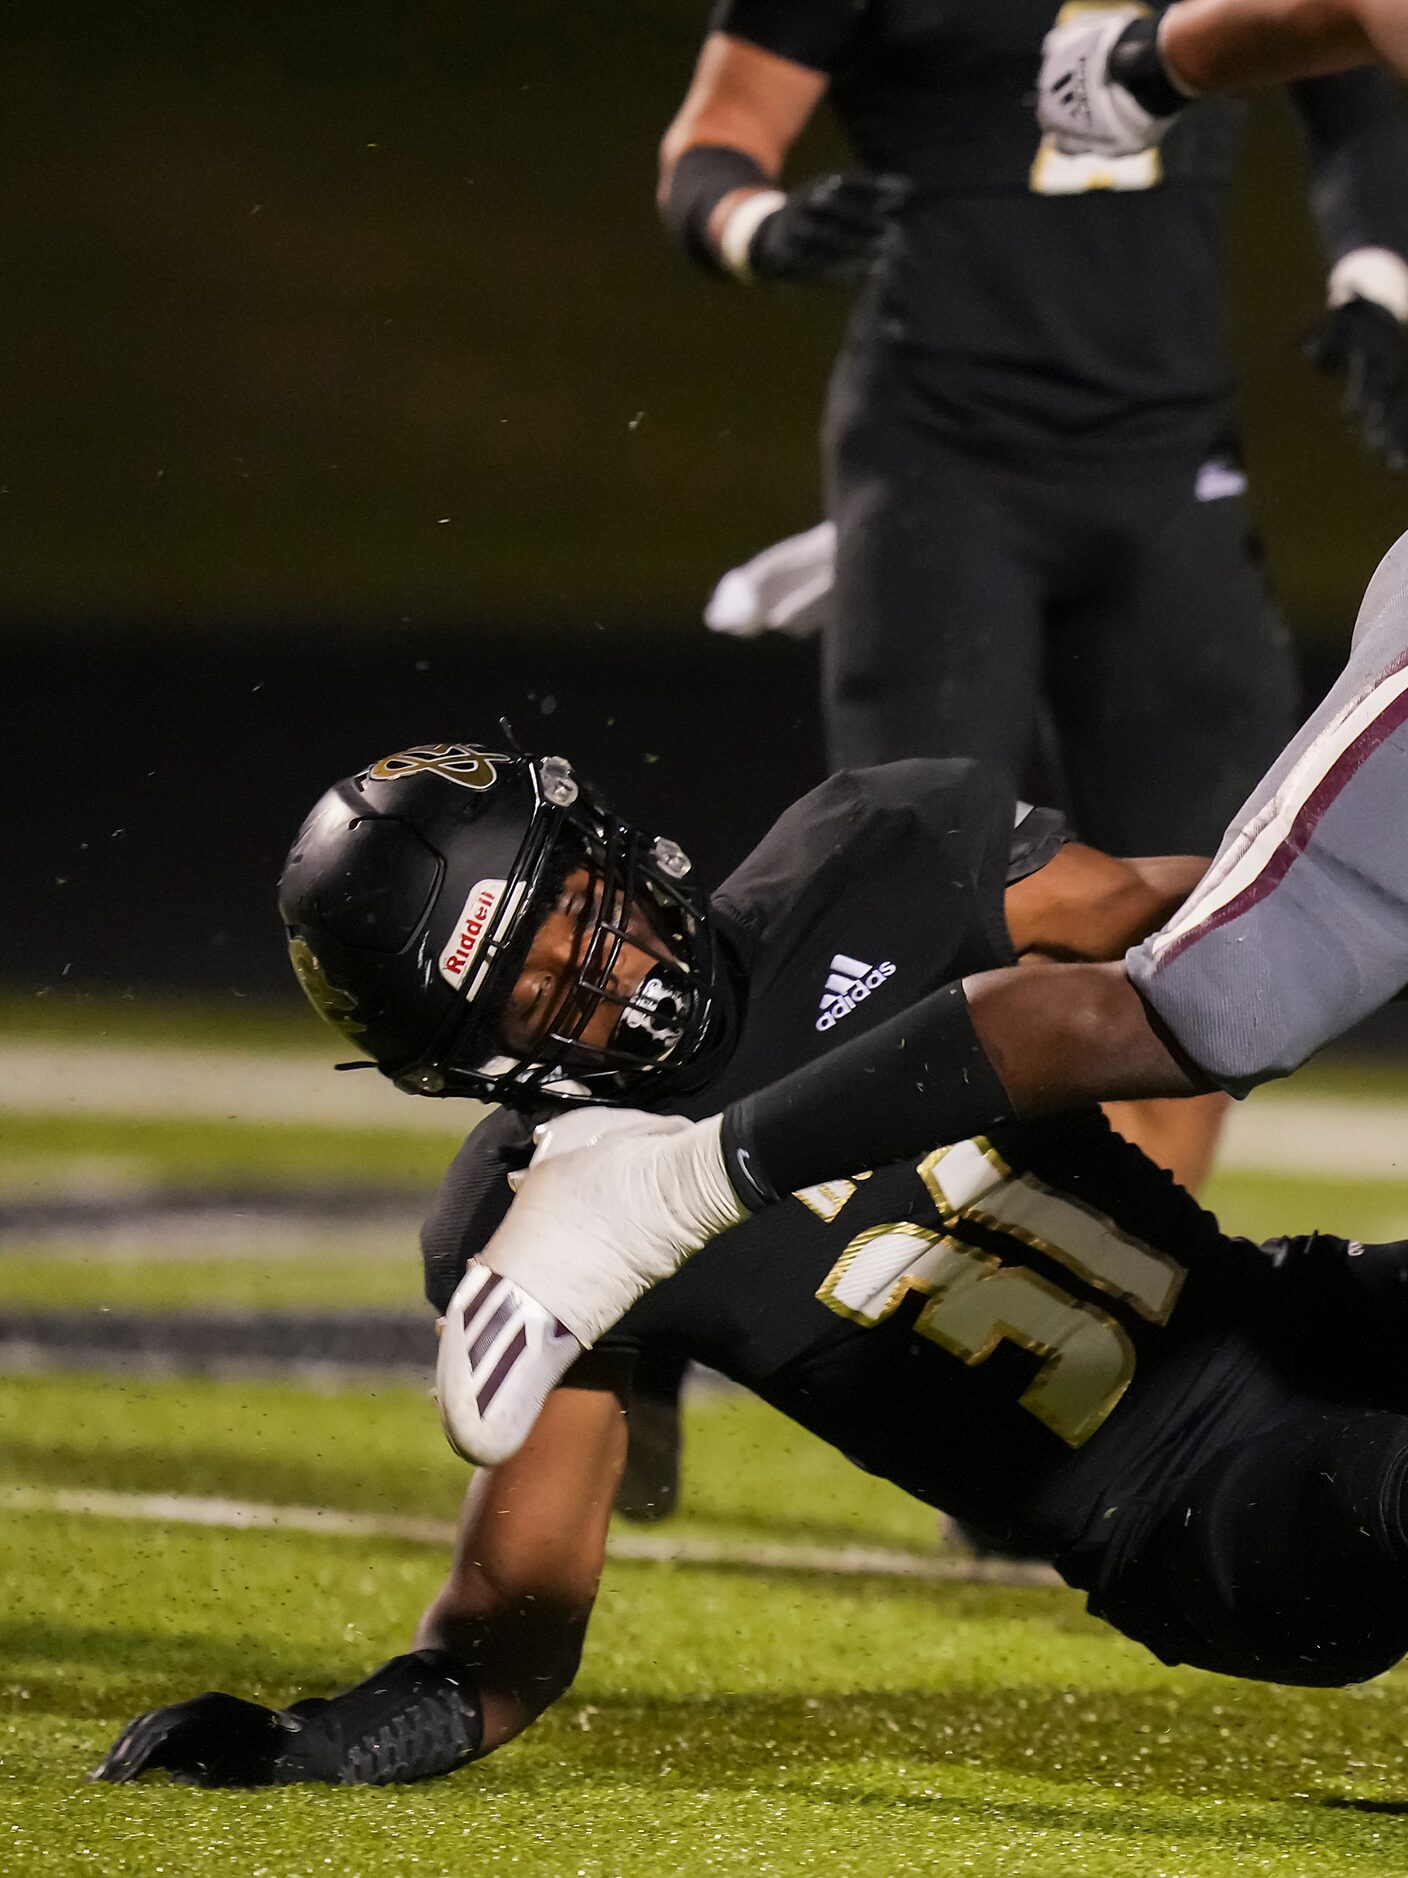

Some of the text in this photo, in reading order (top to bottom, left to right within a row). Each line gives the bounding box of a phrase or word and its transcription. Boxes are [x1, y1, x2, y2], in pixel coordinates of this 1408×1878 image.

[445, 891, 496, 975] Riddell
[815, 961, 897, 1032] adidas
[814, 1135, 1188, 1449] 31
